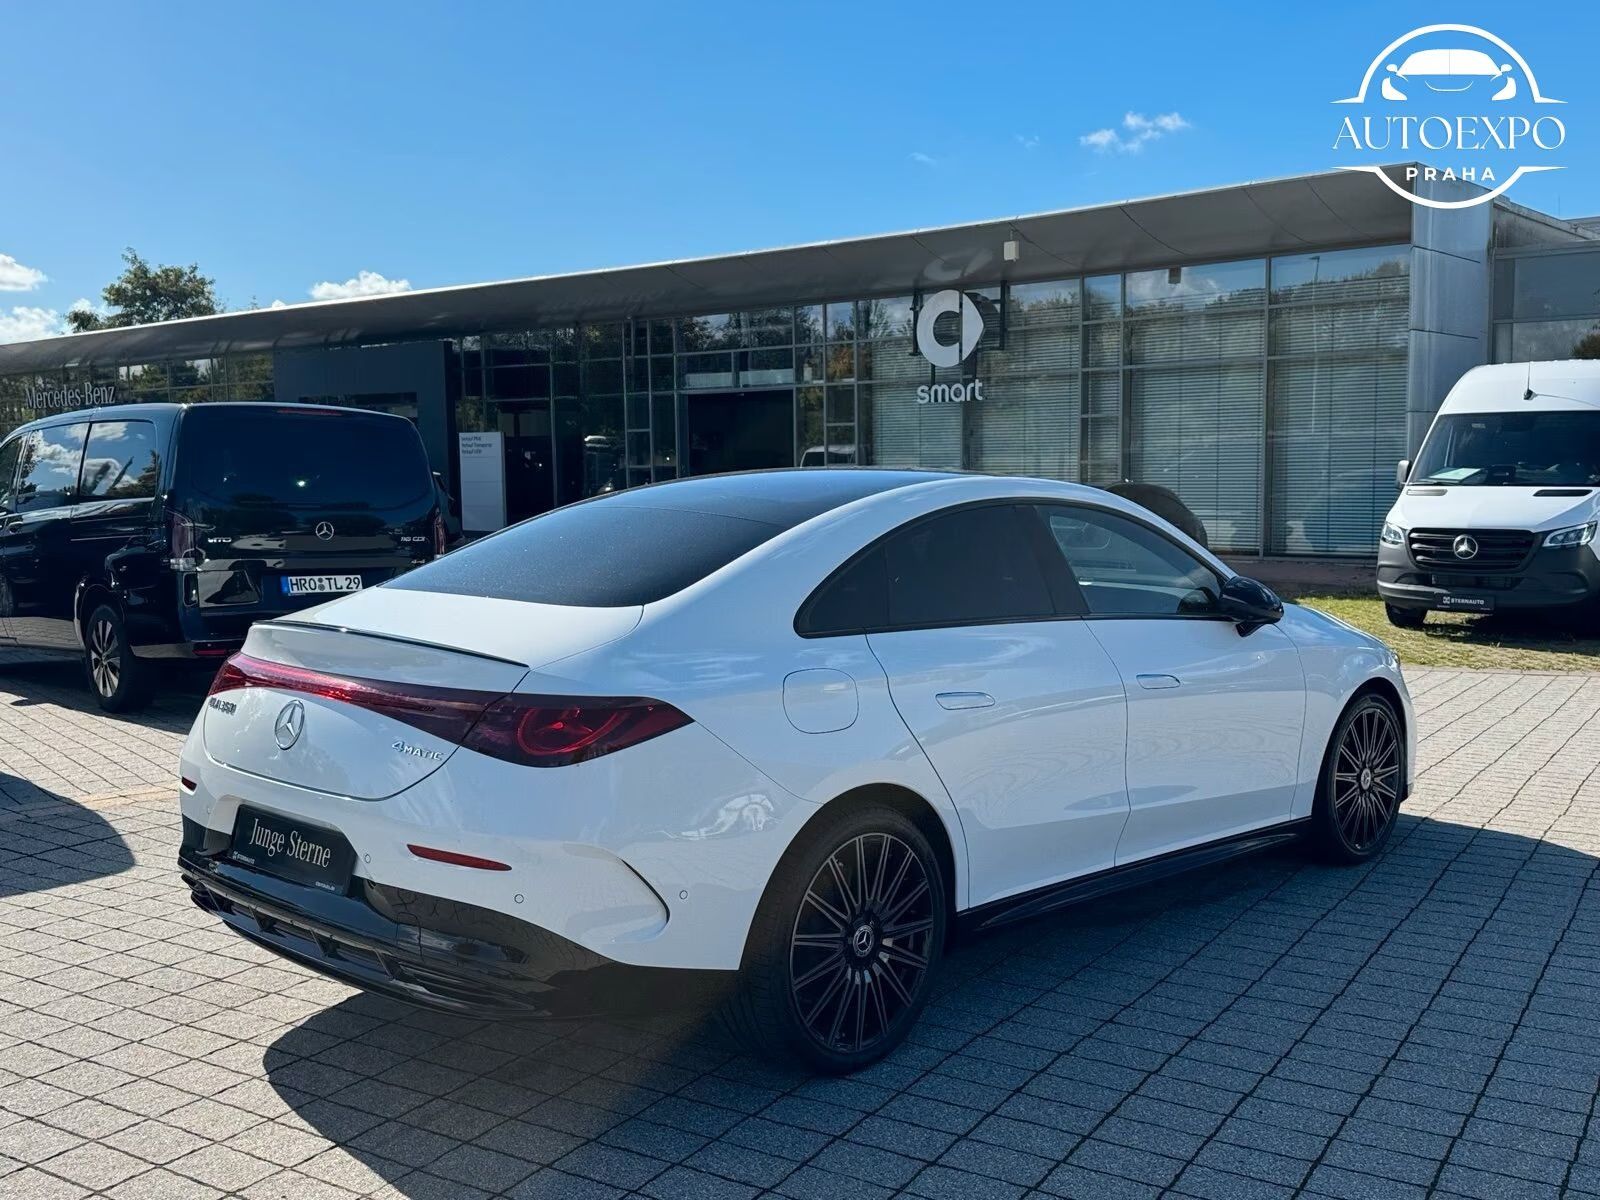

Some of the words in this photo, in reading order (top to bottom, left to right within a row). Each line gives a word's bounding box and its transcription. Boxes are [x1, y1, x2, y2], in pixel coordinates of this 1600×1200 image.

[25, 381, 115, 409] Mercedes-Benz
[916, 378, 983, 404] smart
[289, 578, 317, 592] HRO
[325, 577, 343, 590] TL
[345, 576, 361, 590] 29
[391, 740, 444, 761] 4MATIC
[249, 818, 285, 857] Junge
[287, 830, 331, 868] Sterne
